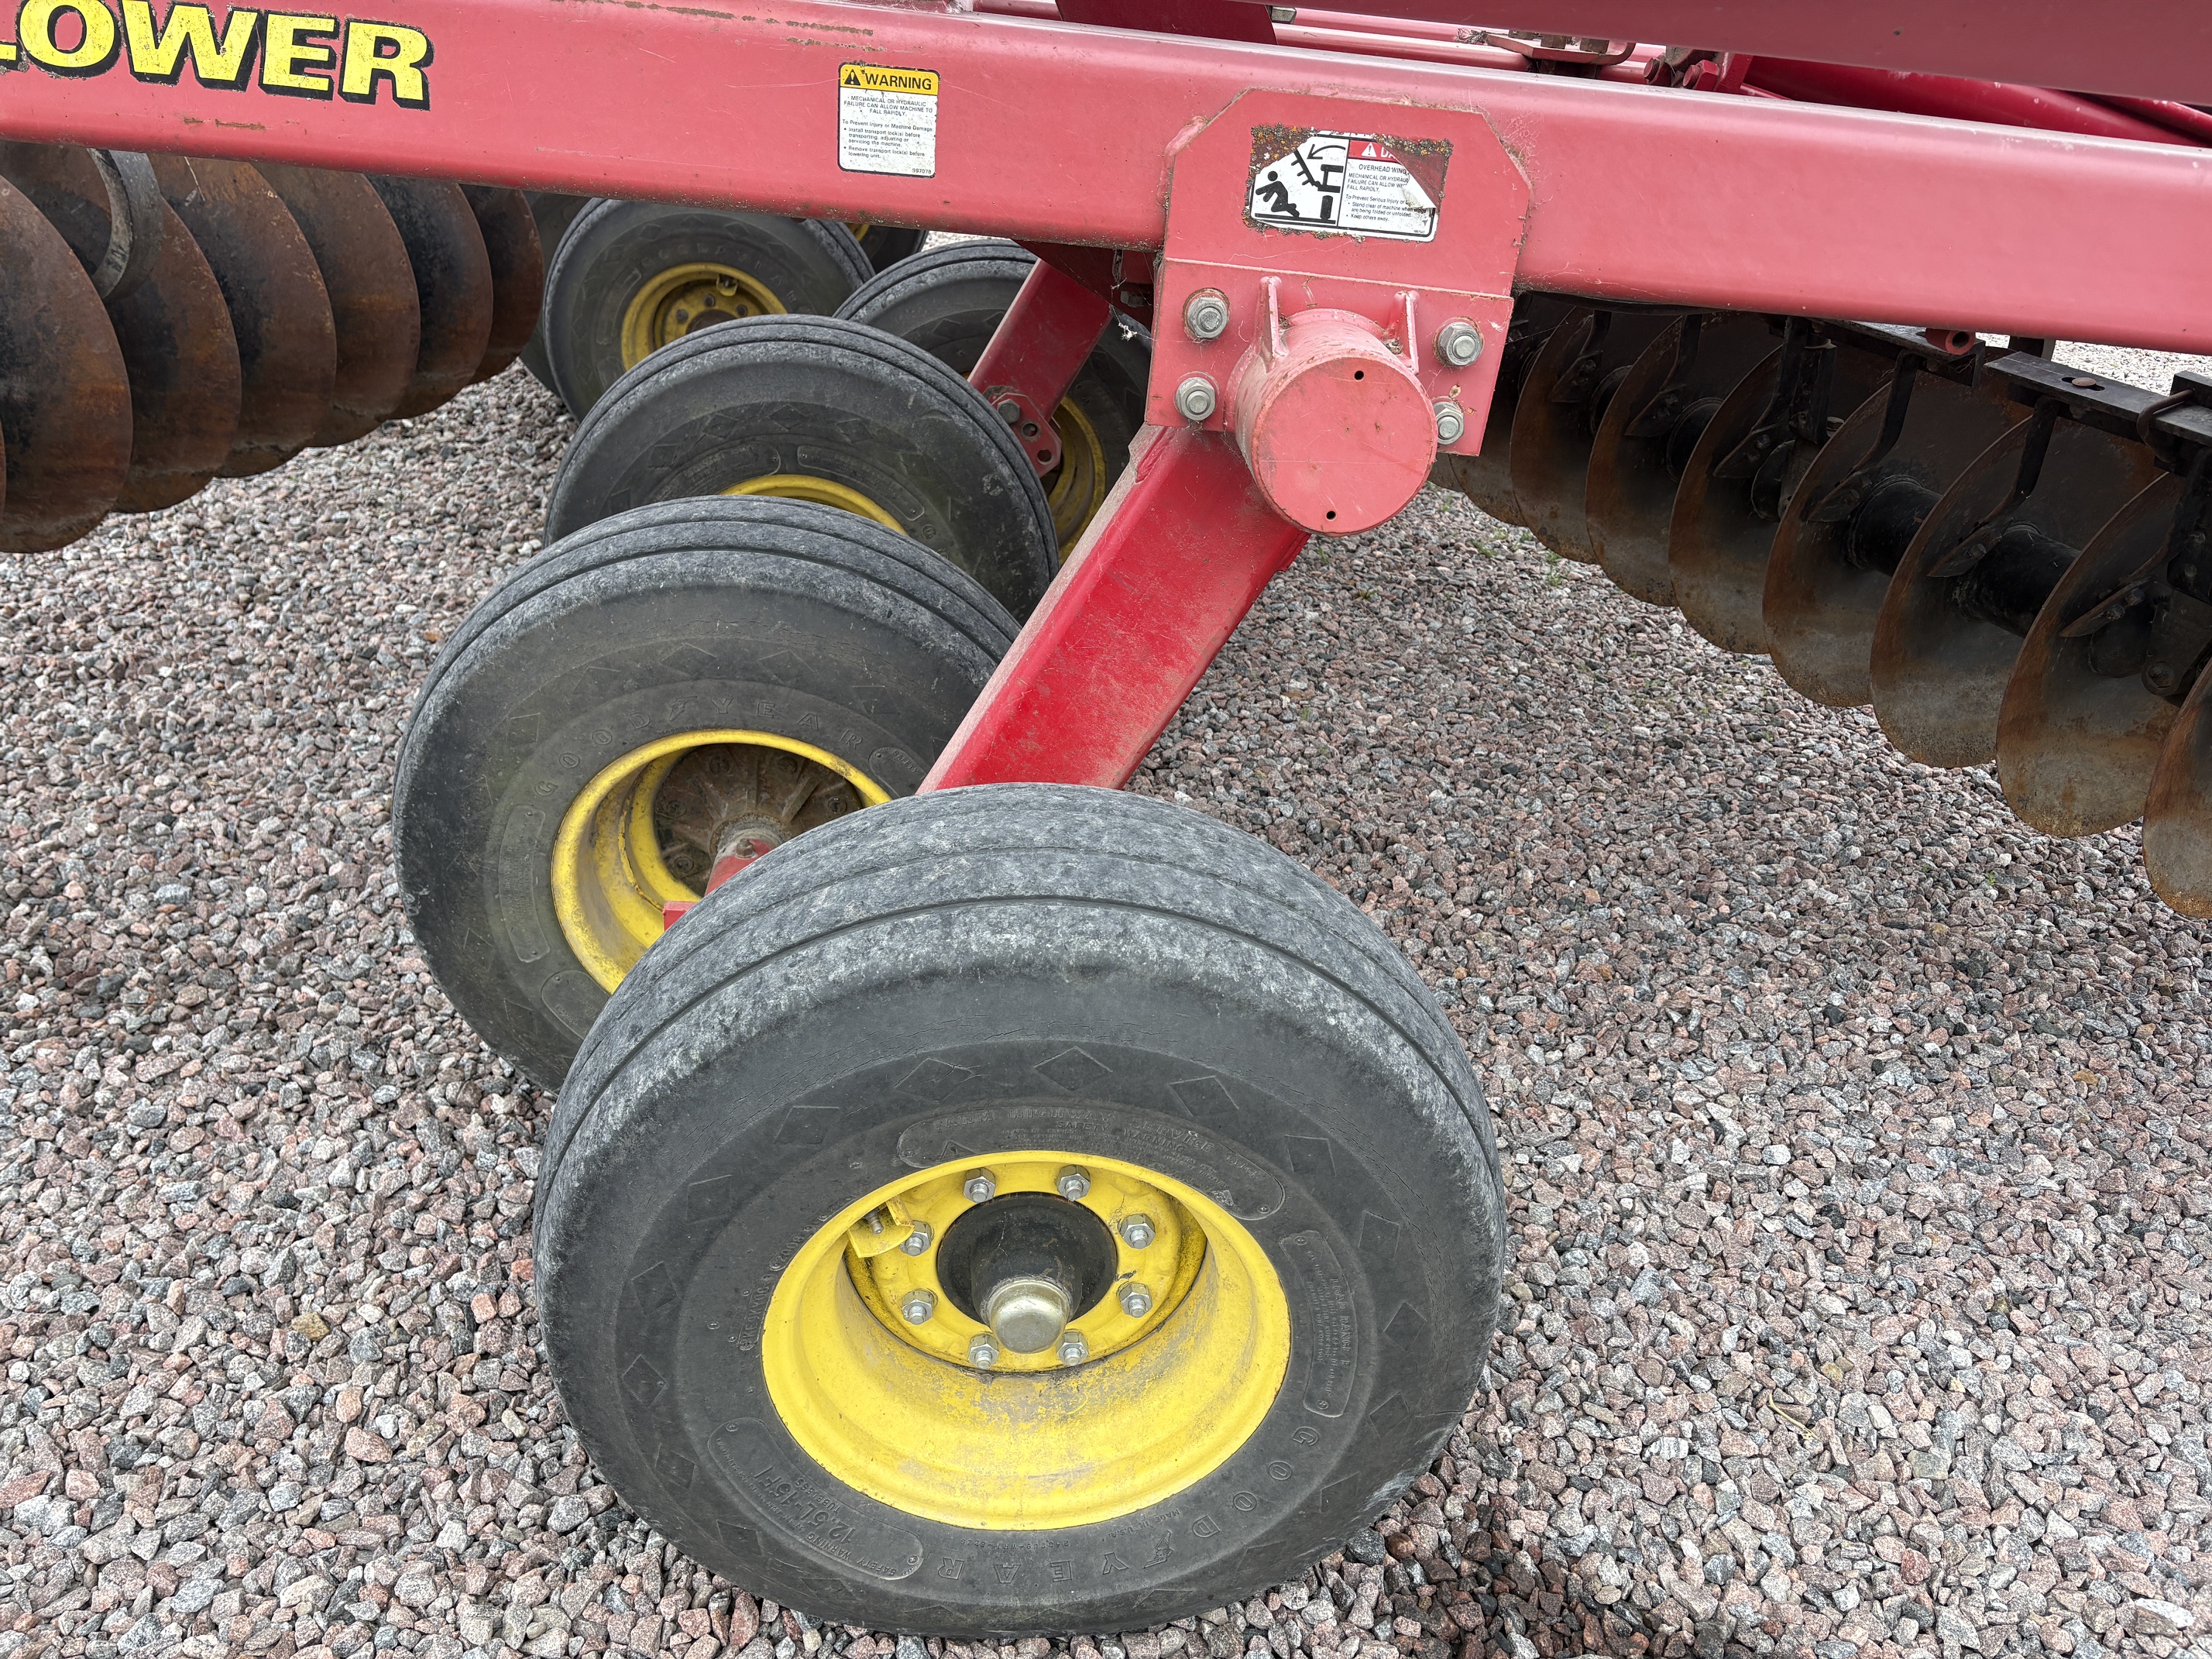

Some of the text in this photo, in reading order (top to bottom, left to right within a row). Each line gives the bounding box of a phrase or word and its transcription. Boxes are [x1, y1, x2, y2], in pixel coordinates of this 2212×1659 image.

[0, 0, 431, 111] OWER
[864, 72, 932, 90] WARNING
[1358, 164, 1390, 173] OVERHEAD
[534, 696, 864, 797] GOODYEAR
[890, 747, 919, 774] SAFETY
[1056, 1121, 1111, 1132] SAFETY
[1339, 1316, 1352, 1356] RANGE
[795, 1478, 841, 1514] TUBELESS
[937, 1426, 1319, 1583] GOODYEAR
[1138, 1520, 1151, 1530] IN
[1154, 1508, 1180, 1523] MADE
[806, 1532, 852, 1561] WARNING
[856, 1557, 898, 1576] SAFETY
